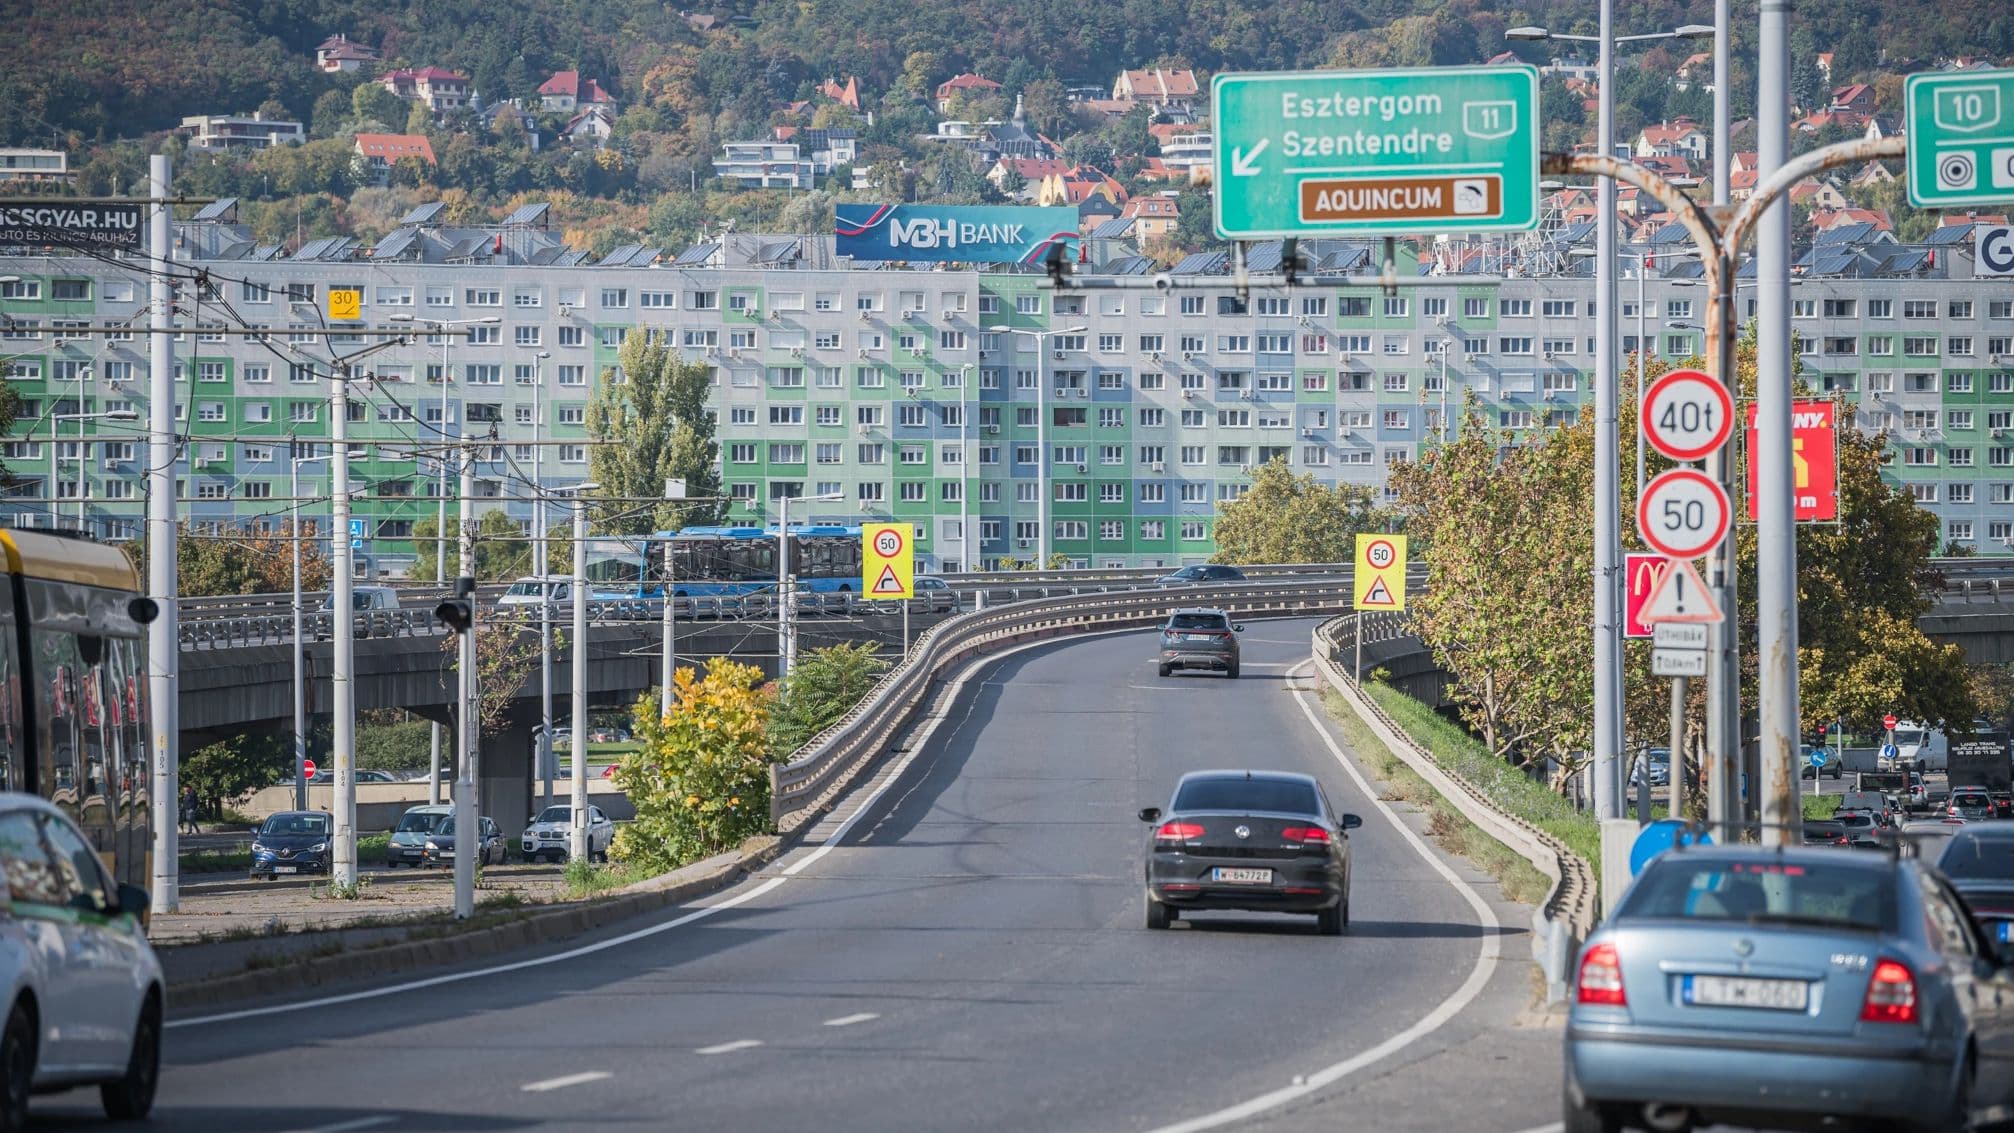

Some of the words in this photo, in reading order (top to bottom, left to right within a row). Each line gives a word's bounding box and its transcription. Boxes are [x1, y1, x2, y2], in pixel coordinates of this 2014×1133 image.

[1282, 92, 1442, 121] Esztergom
[1481, 108, 1499, 129] 11
[1953, 93, 1982, 121] 10
[1282, 128, 1453, 157] Szentendre
[1315, 187, 1441, 211] AQUINCUM
[890, 218, 956, 248] MBH
[961, 223, 1024, 244] BANK
[334, 291, 352, 304] 30
[1660, 402, 1712, 432] 40t
[1664, 500, 1703, 531] 50
[881, 538, 895, 550] 50
[1374, 549, 1388, 560] 50
